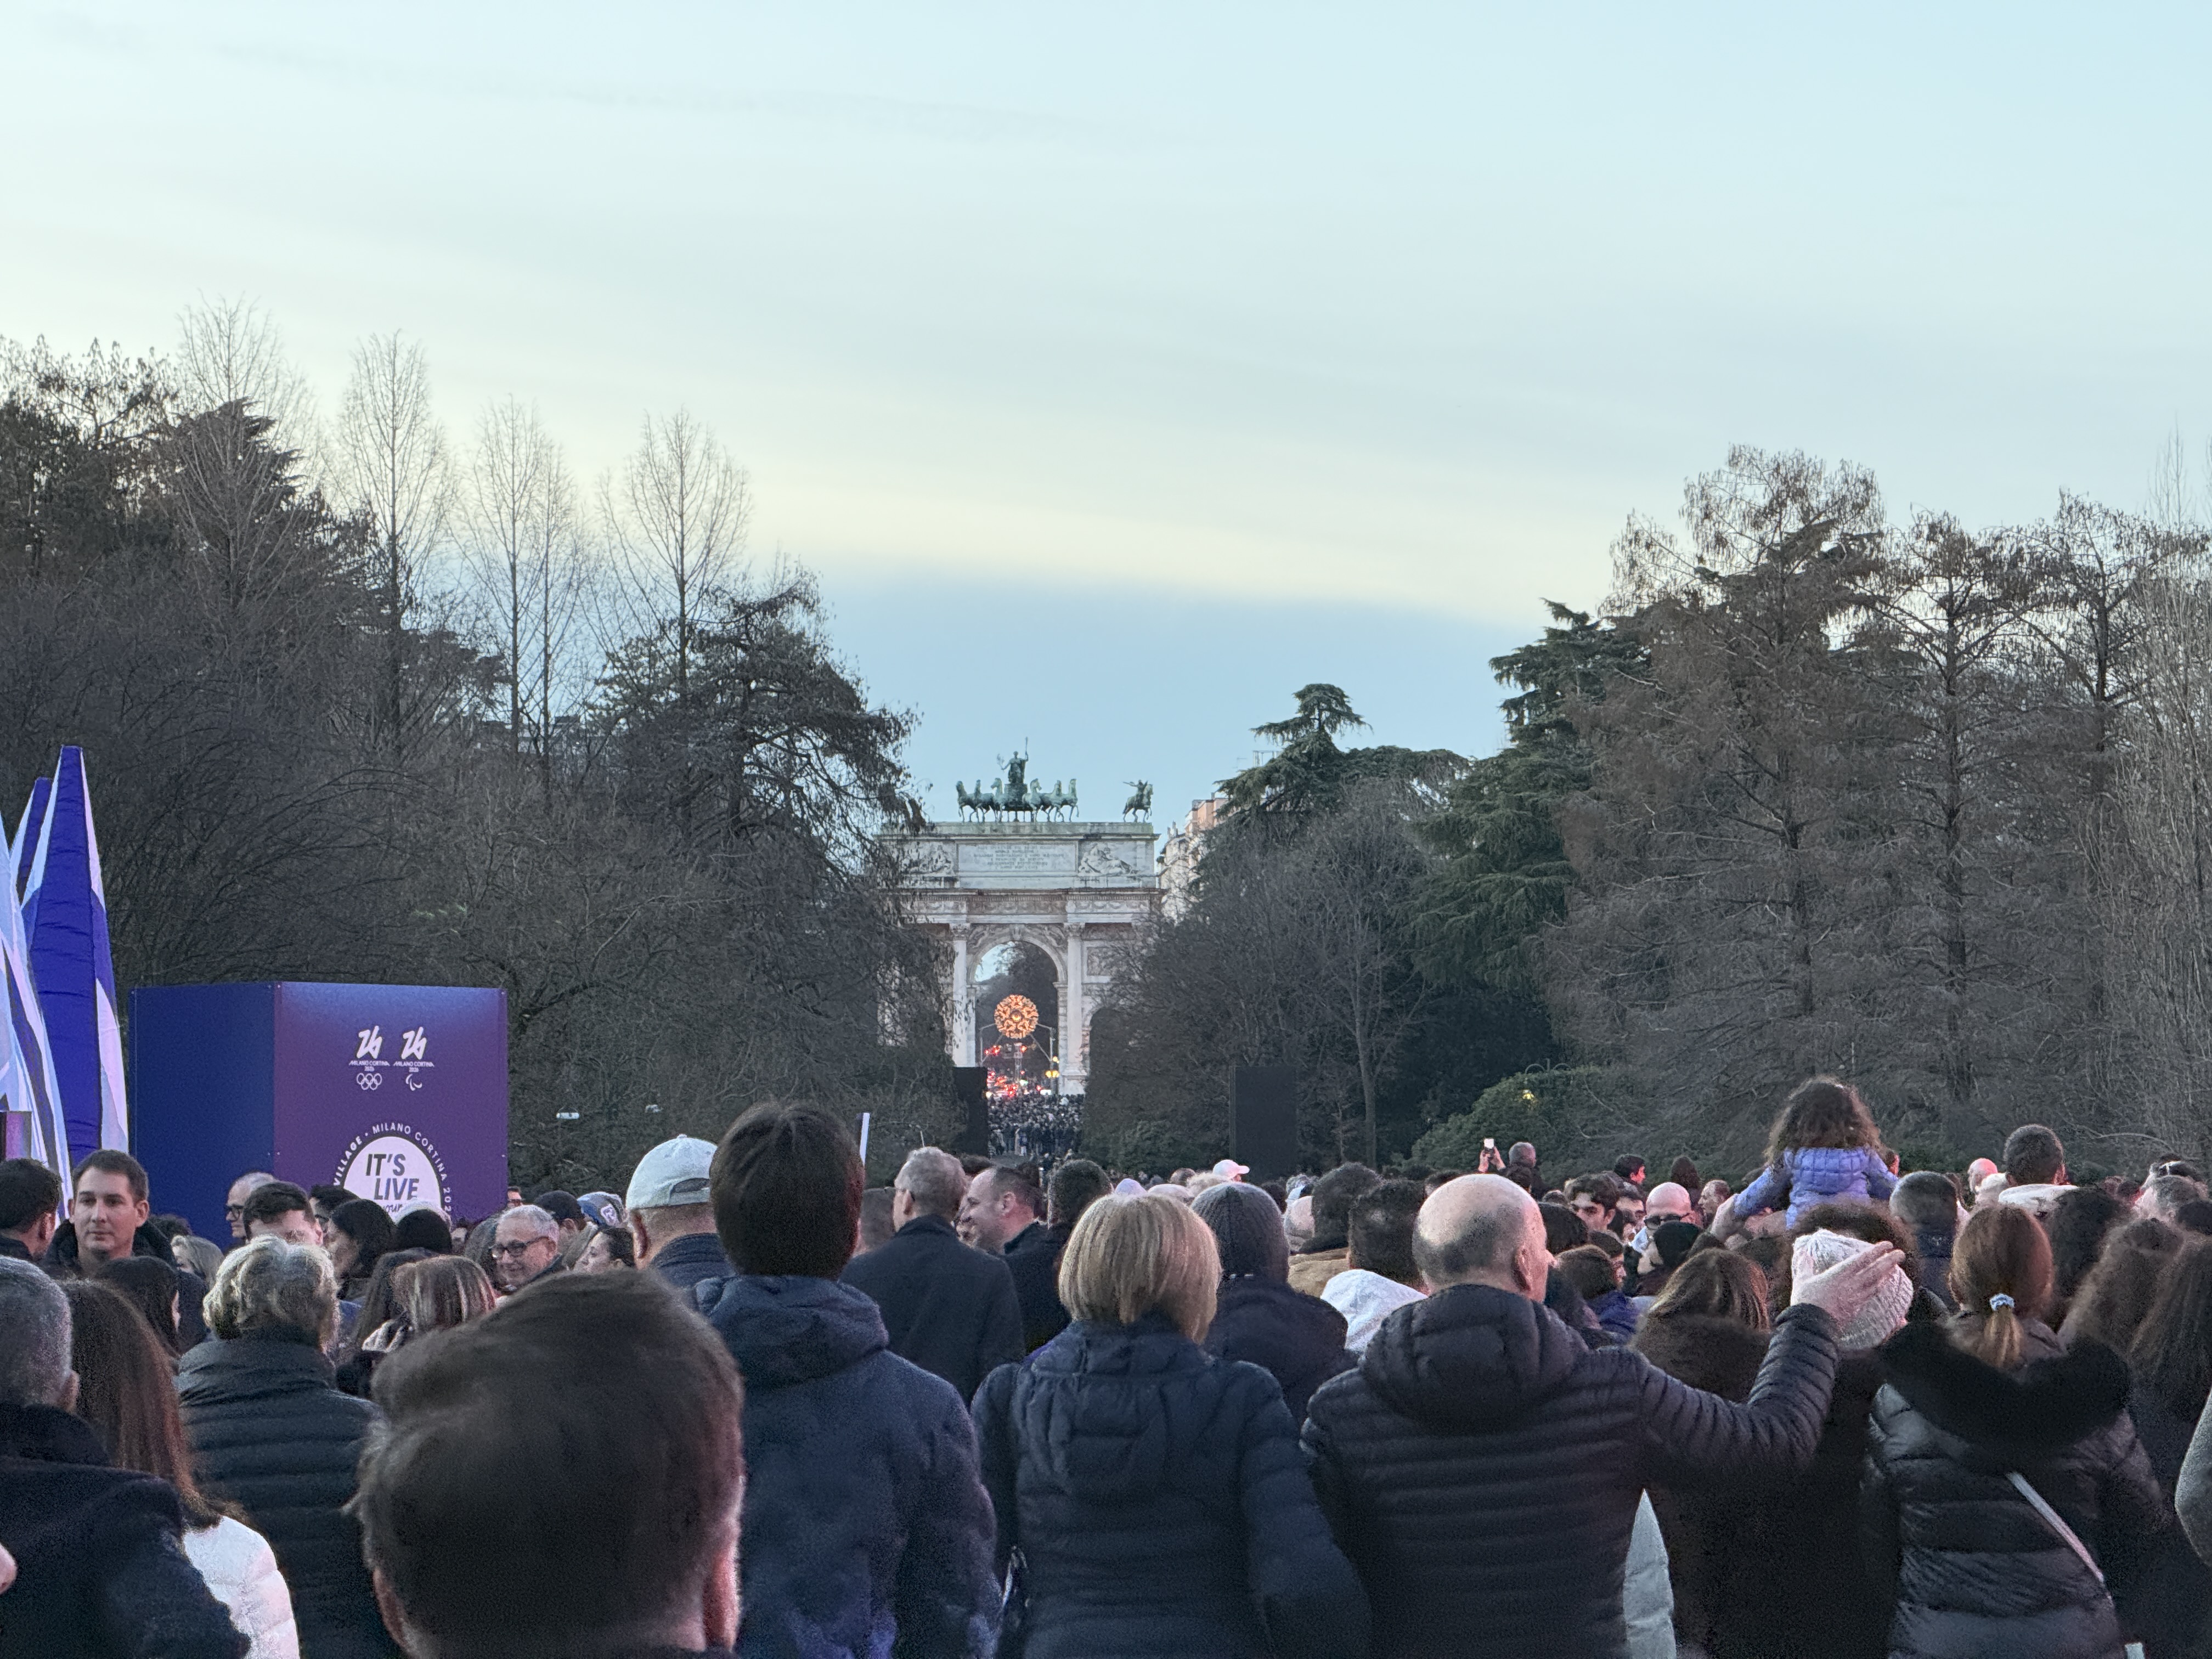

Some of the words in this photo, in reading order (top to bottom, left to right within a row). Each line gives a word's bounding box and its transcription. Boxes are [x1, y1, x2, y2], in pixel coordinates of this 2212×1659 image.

[334, 1136, 362, 1186] VILLAGE
[373, 1122, 411, 1135] MILANO
[415, 1132, 447, 1181] CORTINA
[443, 1187, 452, 1212] 202
[365, 1154, 406, 1176] IT'S
[374, 1178, 420, 1200] LIVE
